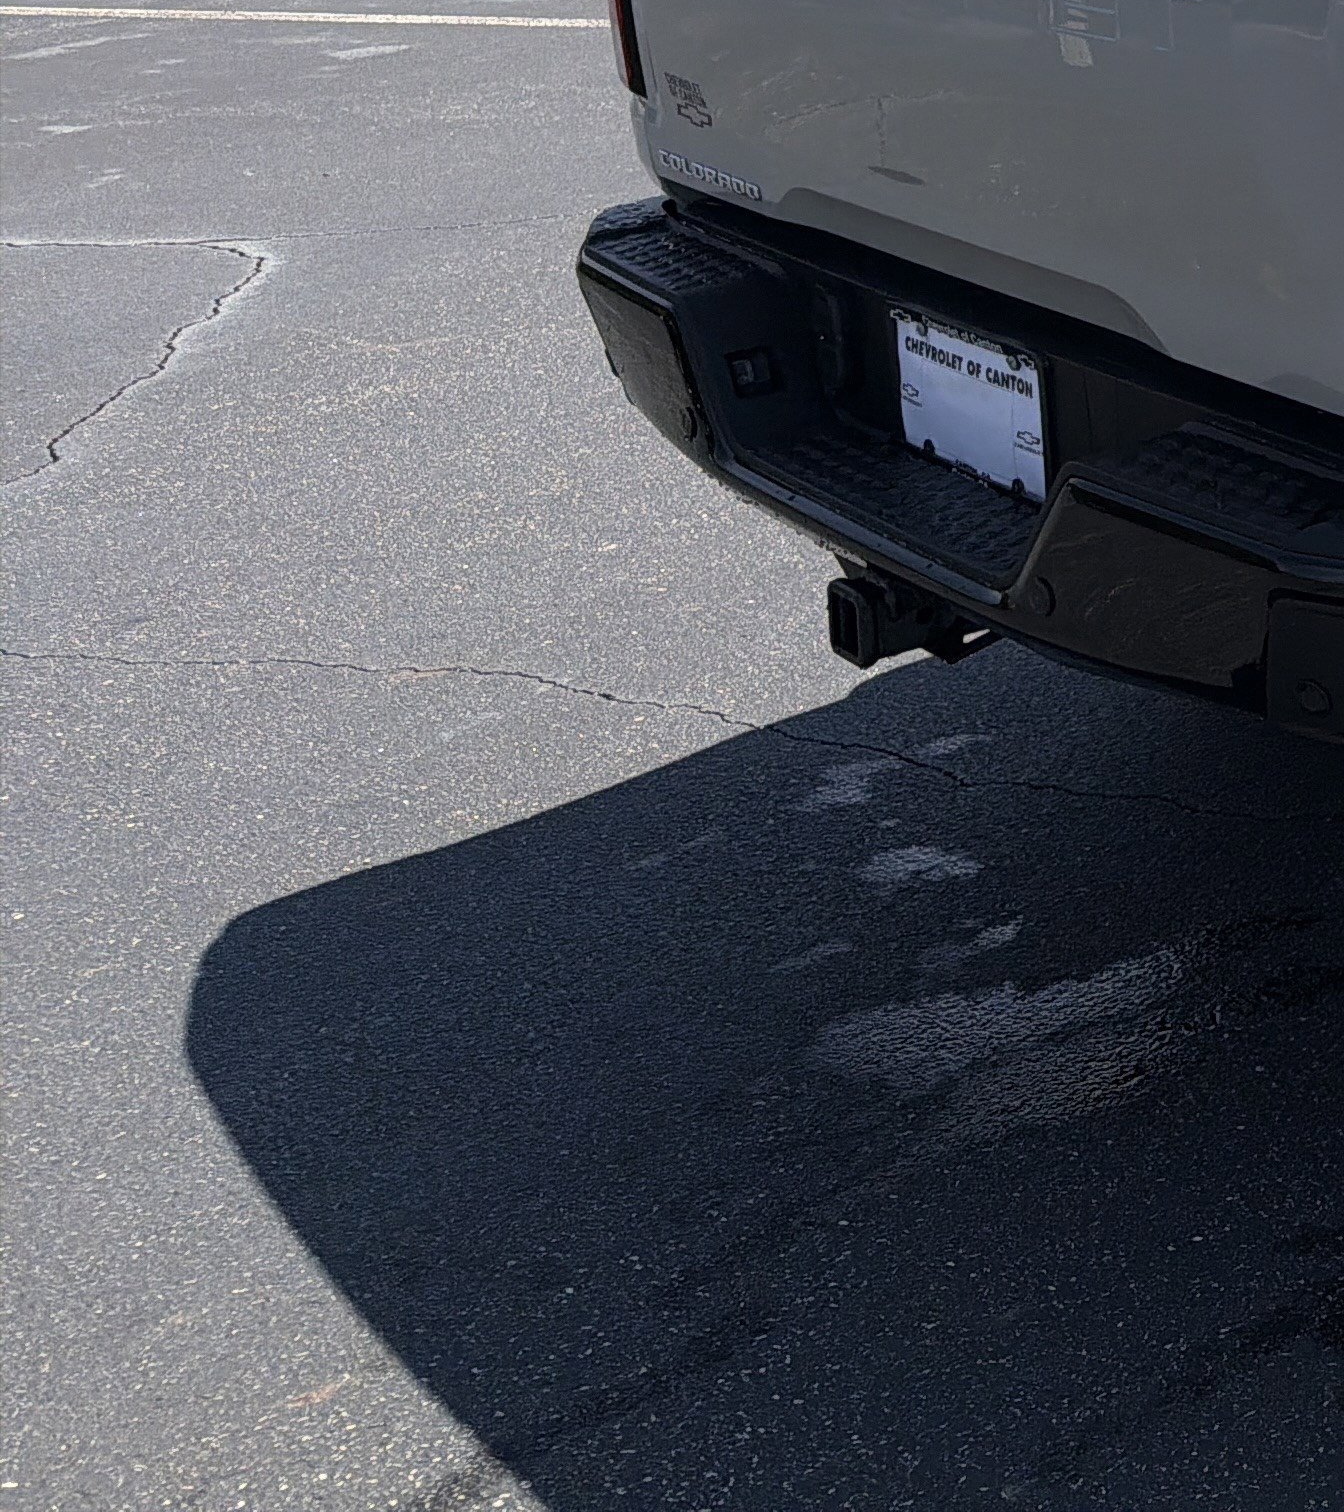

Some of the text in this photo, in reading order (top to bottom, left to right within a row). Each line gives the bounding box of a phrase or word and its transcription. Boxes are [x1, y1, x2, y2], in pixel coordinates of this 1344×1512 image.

[658, 148, 762, 201] COLORADO
[904, 336, 1034, 399] CHEVROLET OF CANTON
